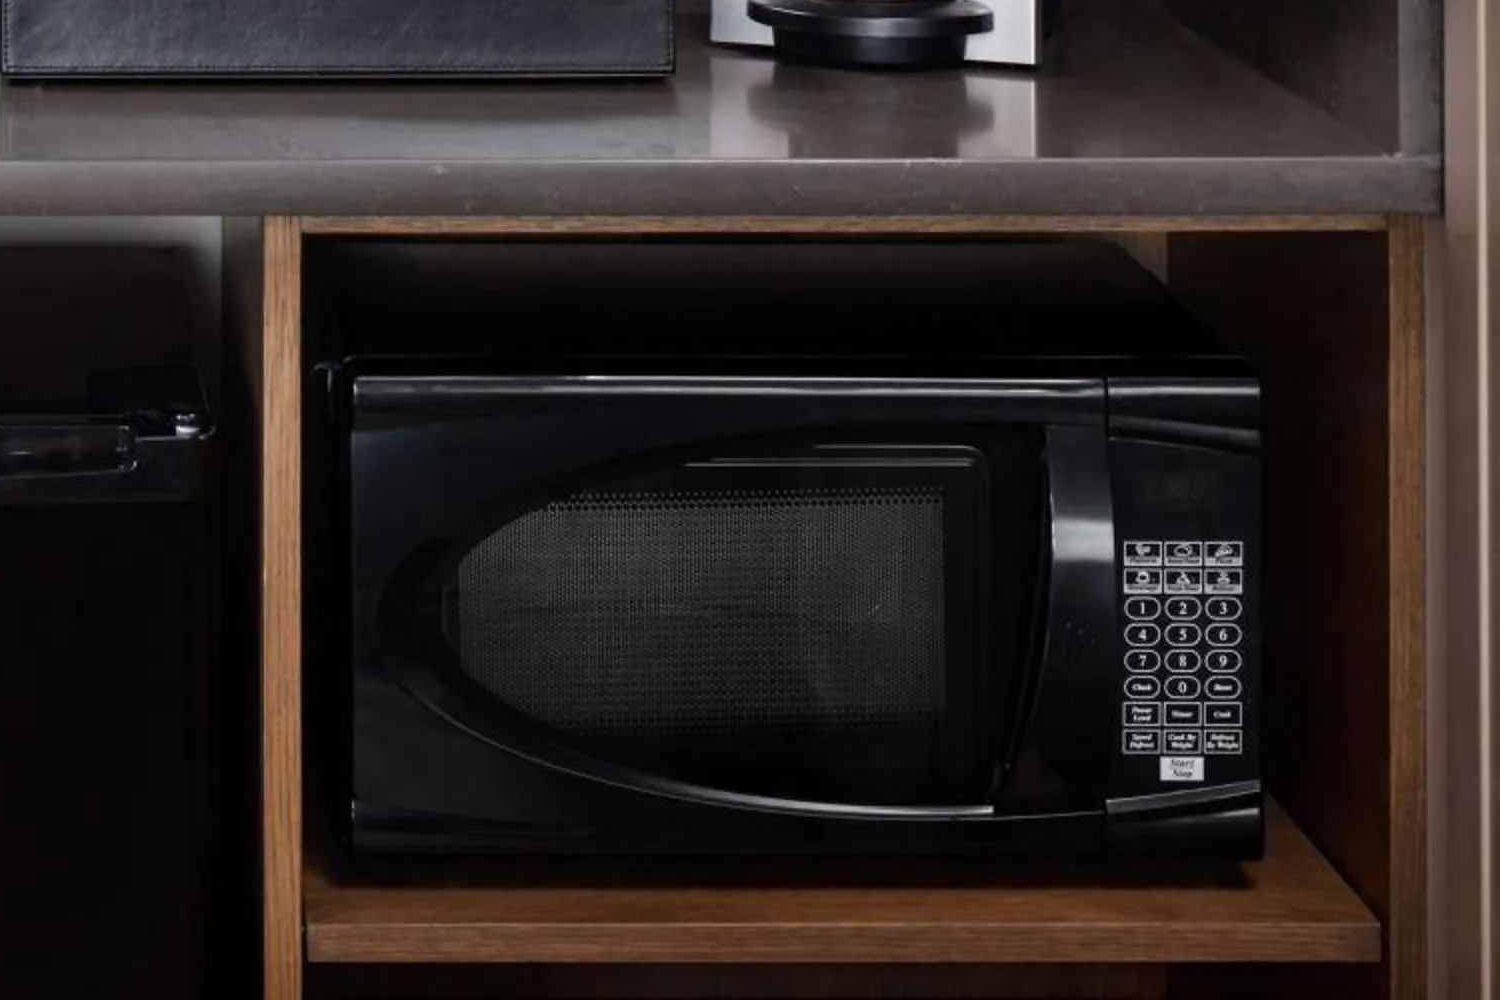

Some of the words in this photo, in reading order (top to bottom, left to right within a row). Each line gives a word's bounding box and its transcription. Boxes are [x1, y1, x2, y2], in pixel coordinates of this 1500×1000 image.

[1140, 601, 1146, 614] 1
[1179, 601, 1187, 615] 2
[1219, 601, 1227, 615] 3
[1138, 628, 1147, 640] 4
[1179, 628, 1187, 640] 5
[1219, 628, 1228, 640] 6
[1139, 654, 1147, 667] 7
[1179, 654, 1187, 667] 8
[1219, 654, 1227, 667] 9
[1178, 681, 1187, 694] 0
